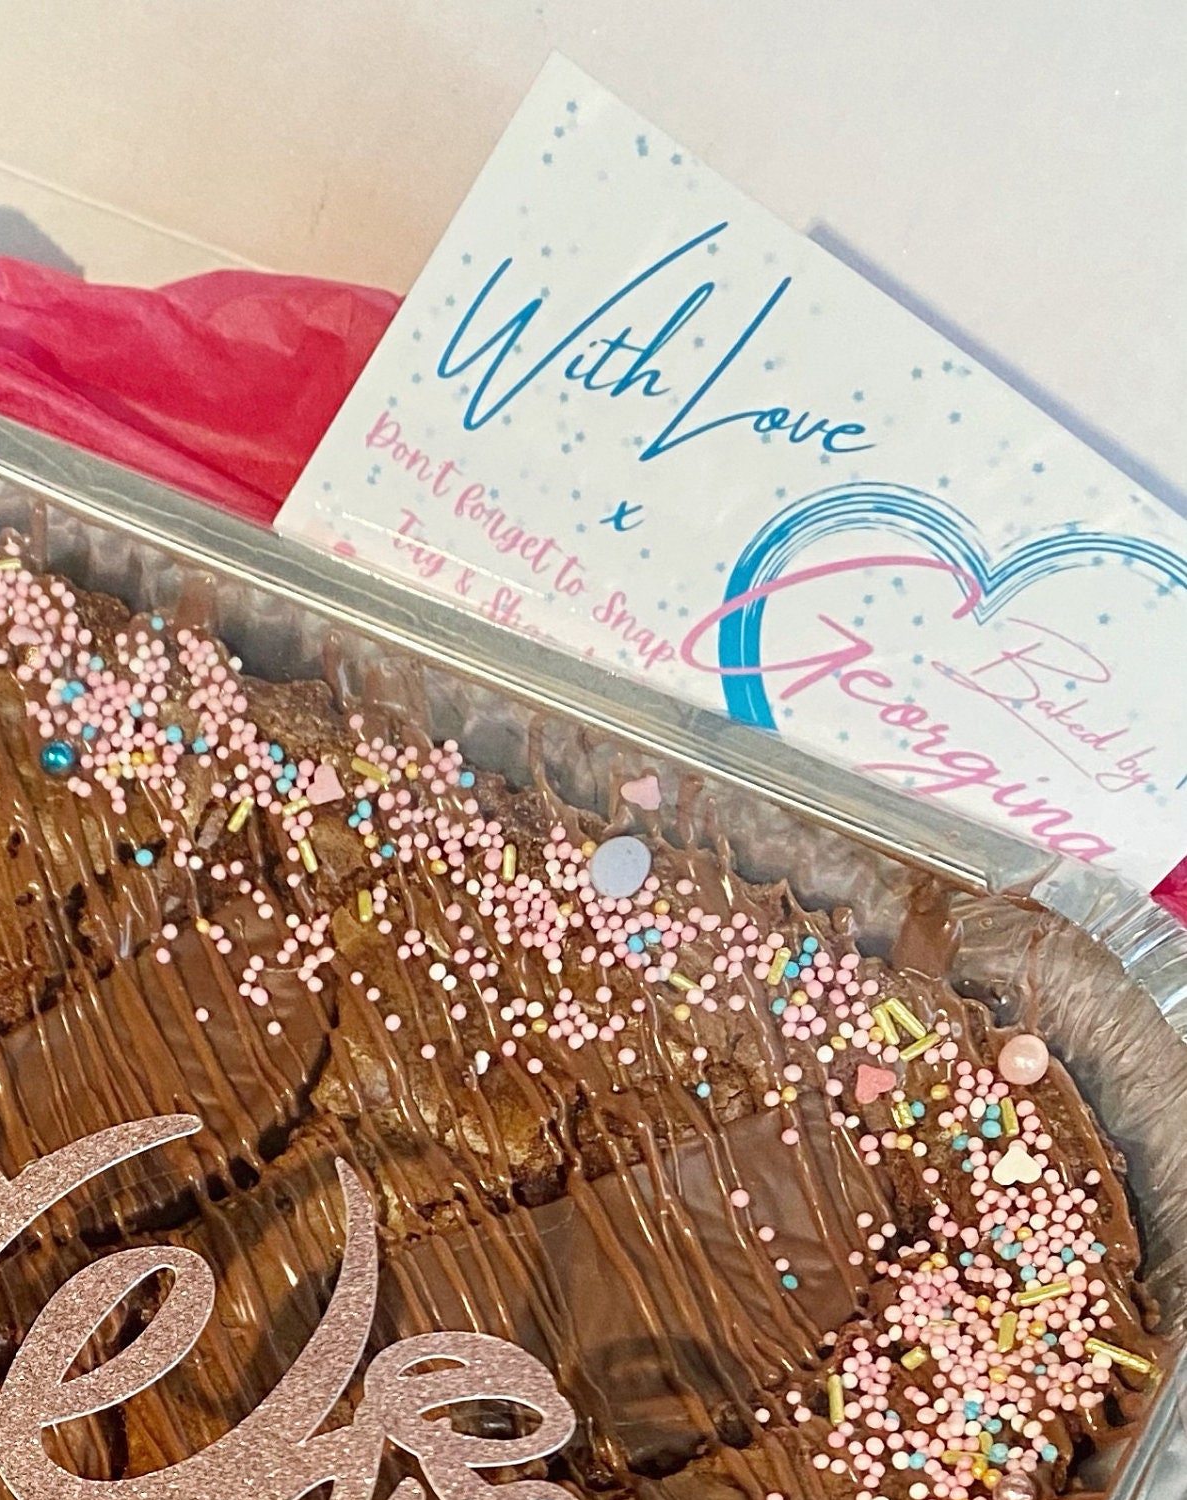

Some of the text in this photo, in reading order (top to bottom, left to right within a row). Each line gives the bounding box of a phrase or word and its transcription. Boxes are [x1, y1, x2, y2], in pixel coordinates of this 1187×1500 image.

[437, 221, 877, 462] With Love
[454, 482, 563, 573] forget
[554, 555, 588, 596] to
[680, 555, 1117, 863] Georgina
[931, 617, 1157, 792] Baked by
